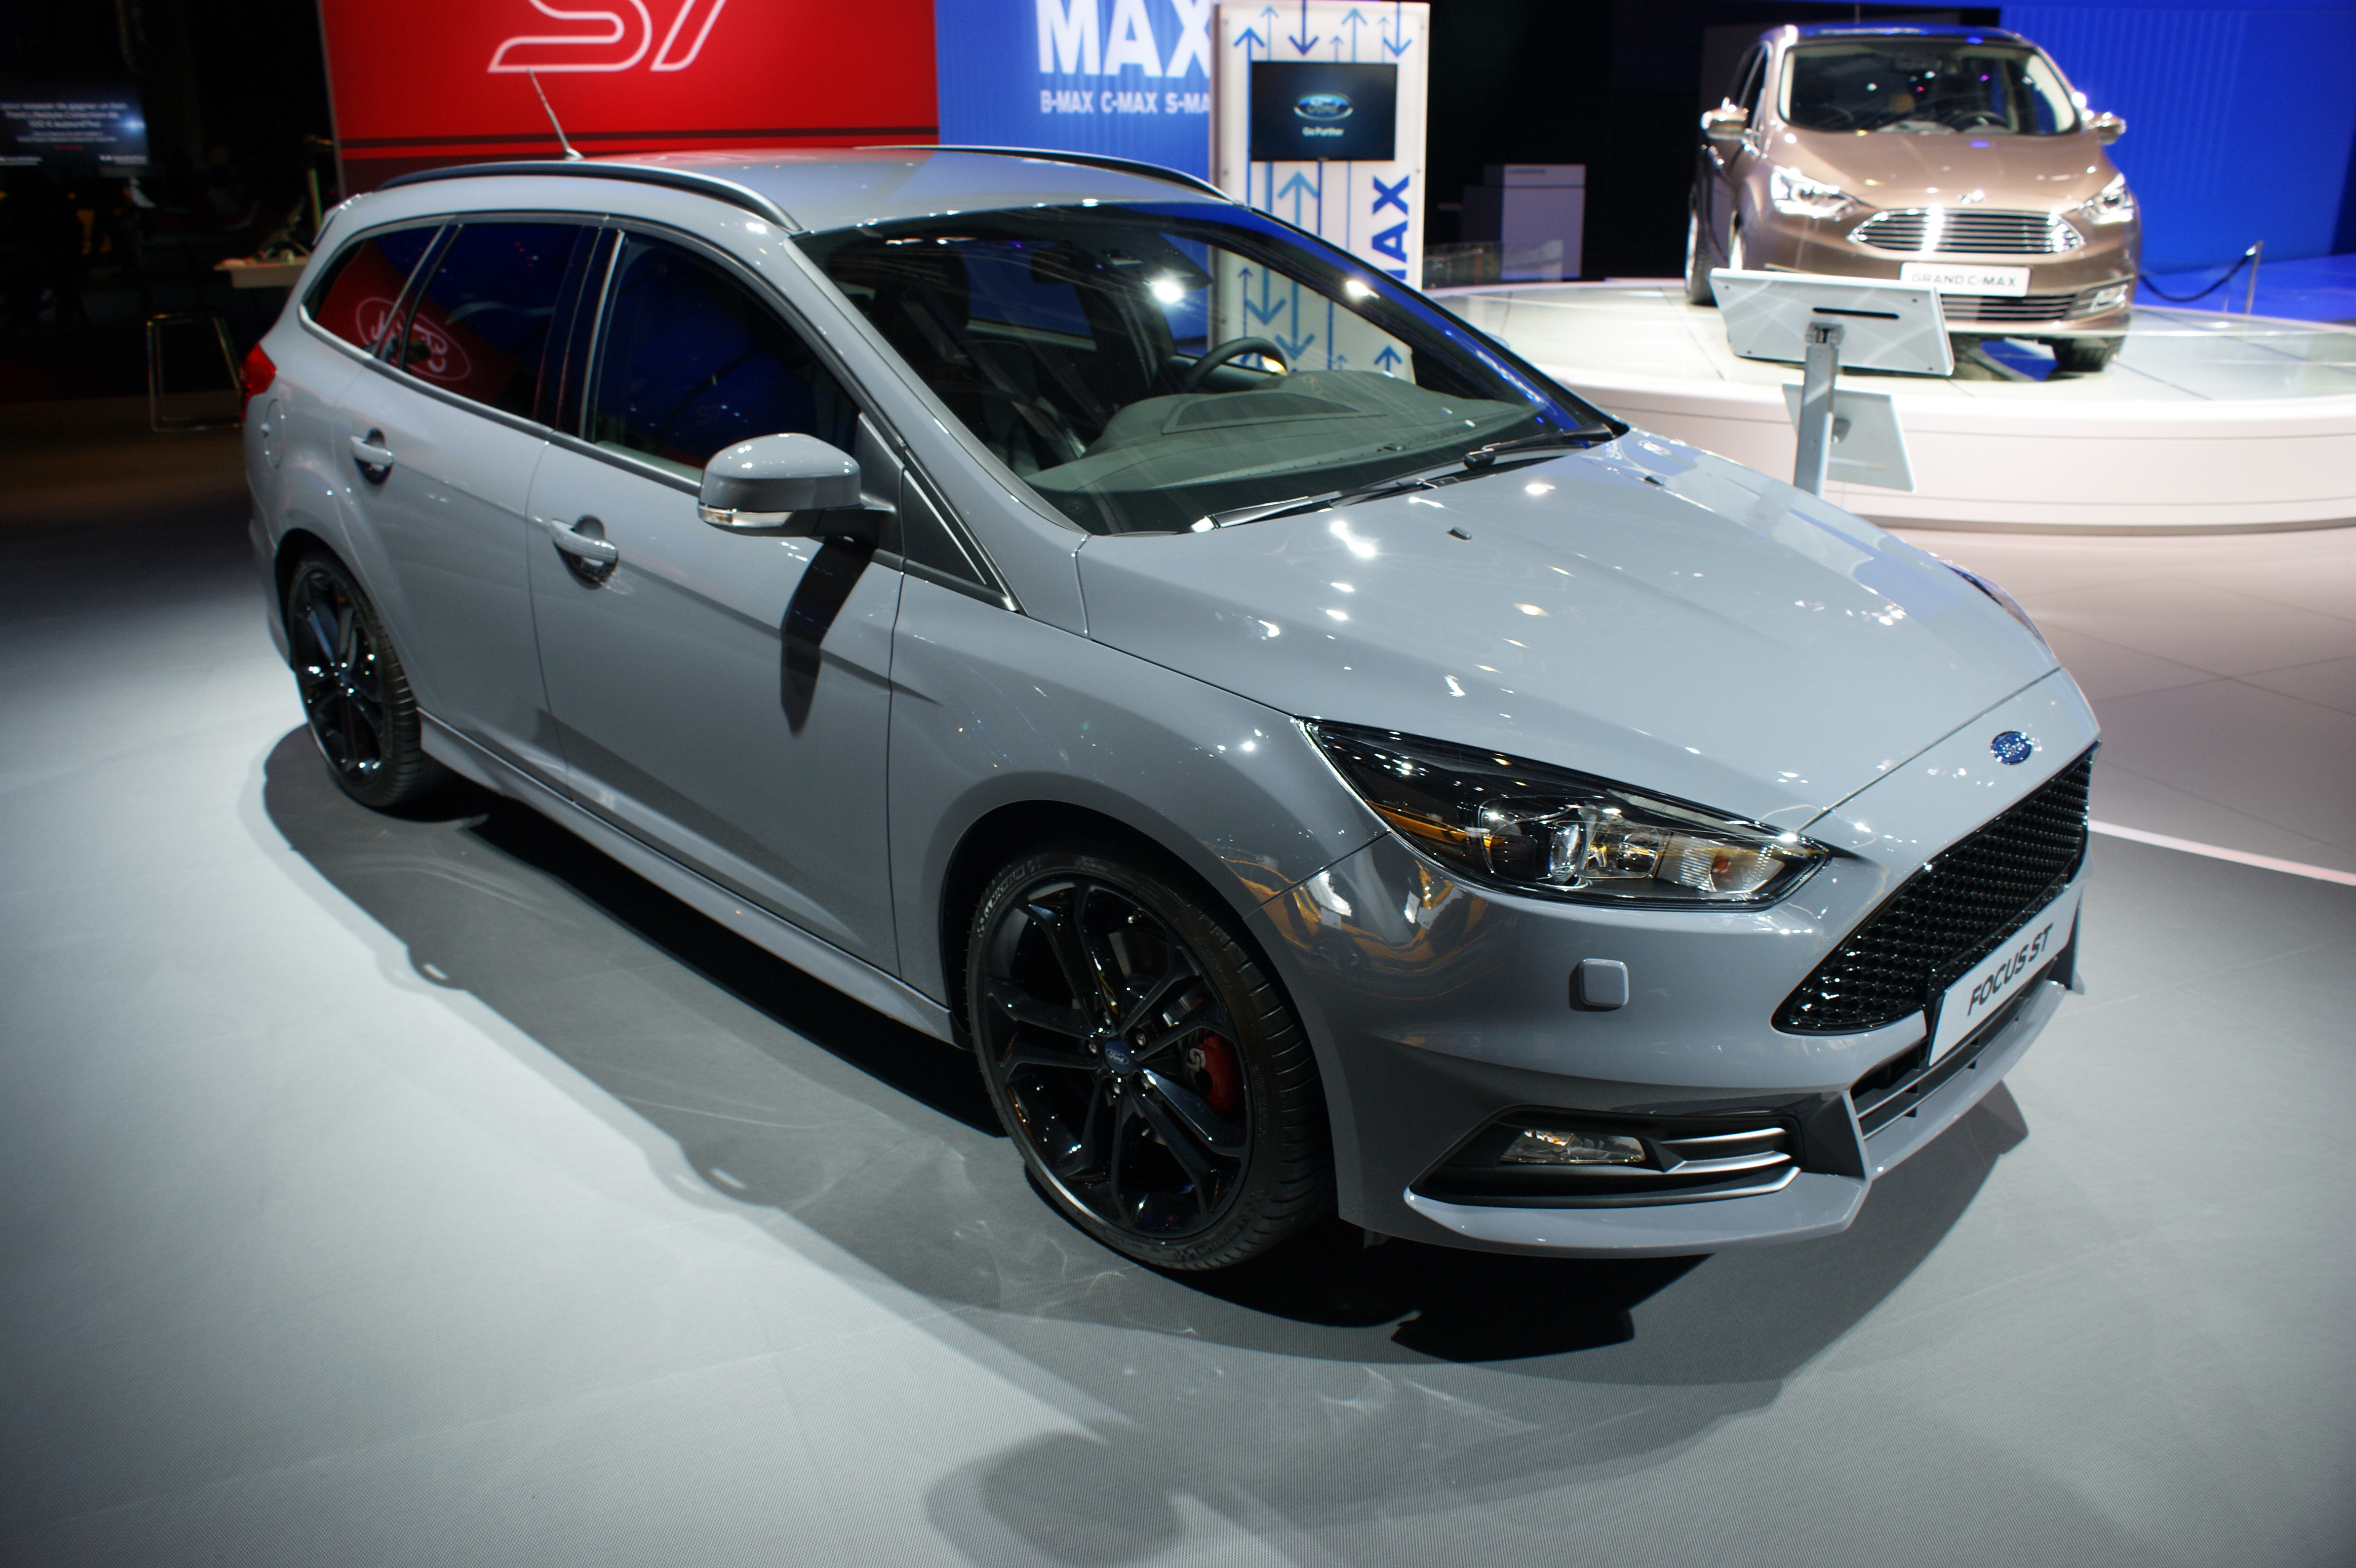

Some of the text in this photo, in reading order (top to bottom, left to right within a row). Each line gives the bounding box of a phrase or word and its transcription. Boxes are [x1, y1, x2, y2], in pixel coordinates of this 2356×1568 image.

[1035, 0, 1210, 78] MAX
[1040, 90, 1210, 114] B-MAX C-MAX S-MA
[1912, 273, 2017, 286] GRAND C-MAX
[1967, 922, 2054, 1016] FOCUS ST
